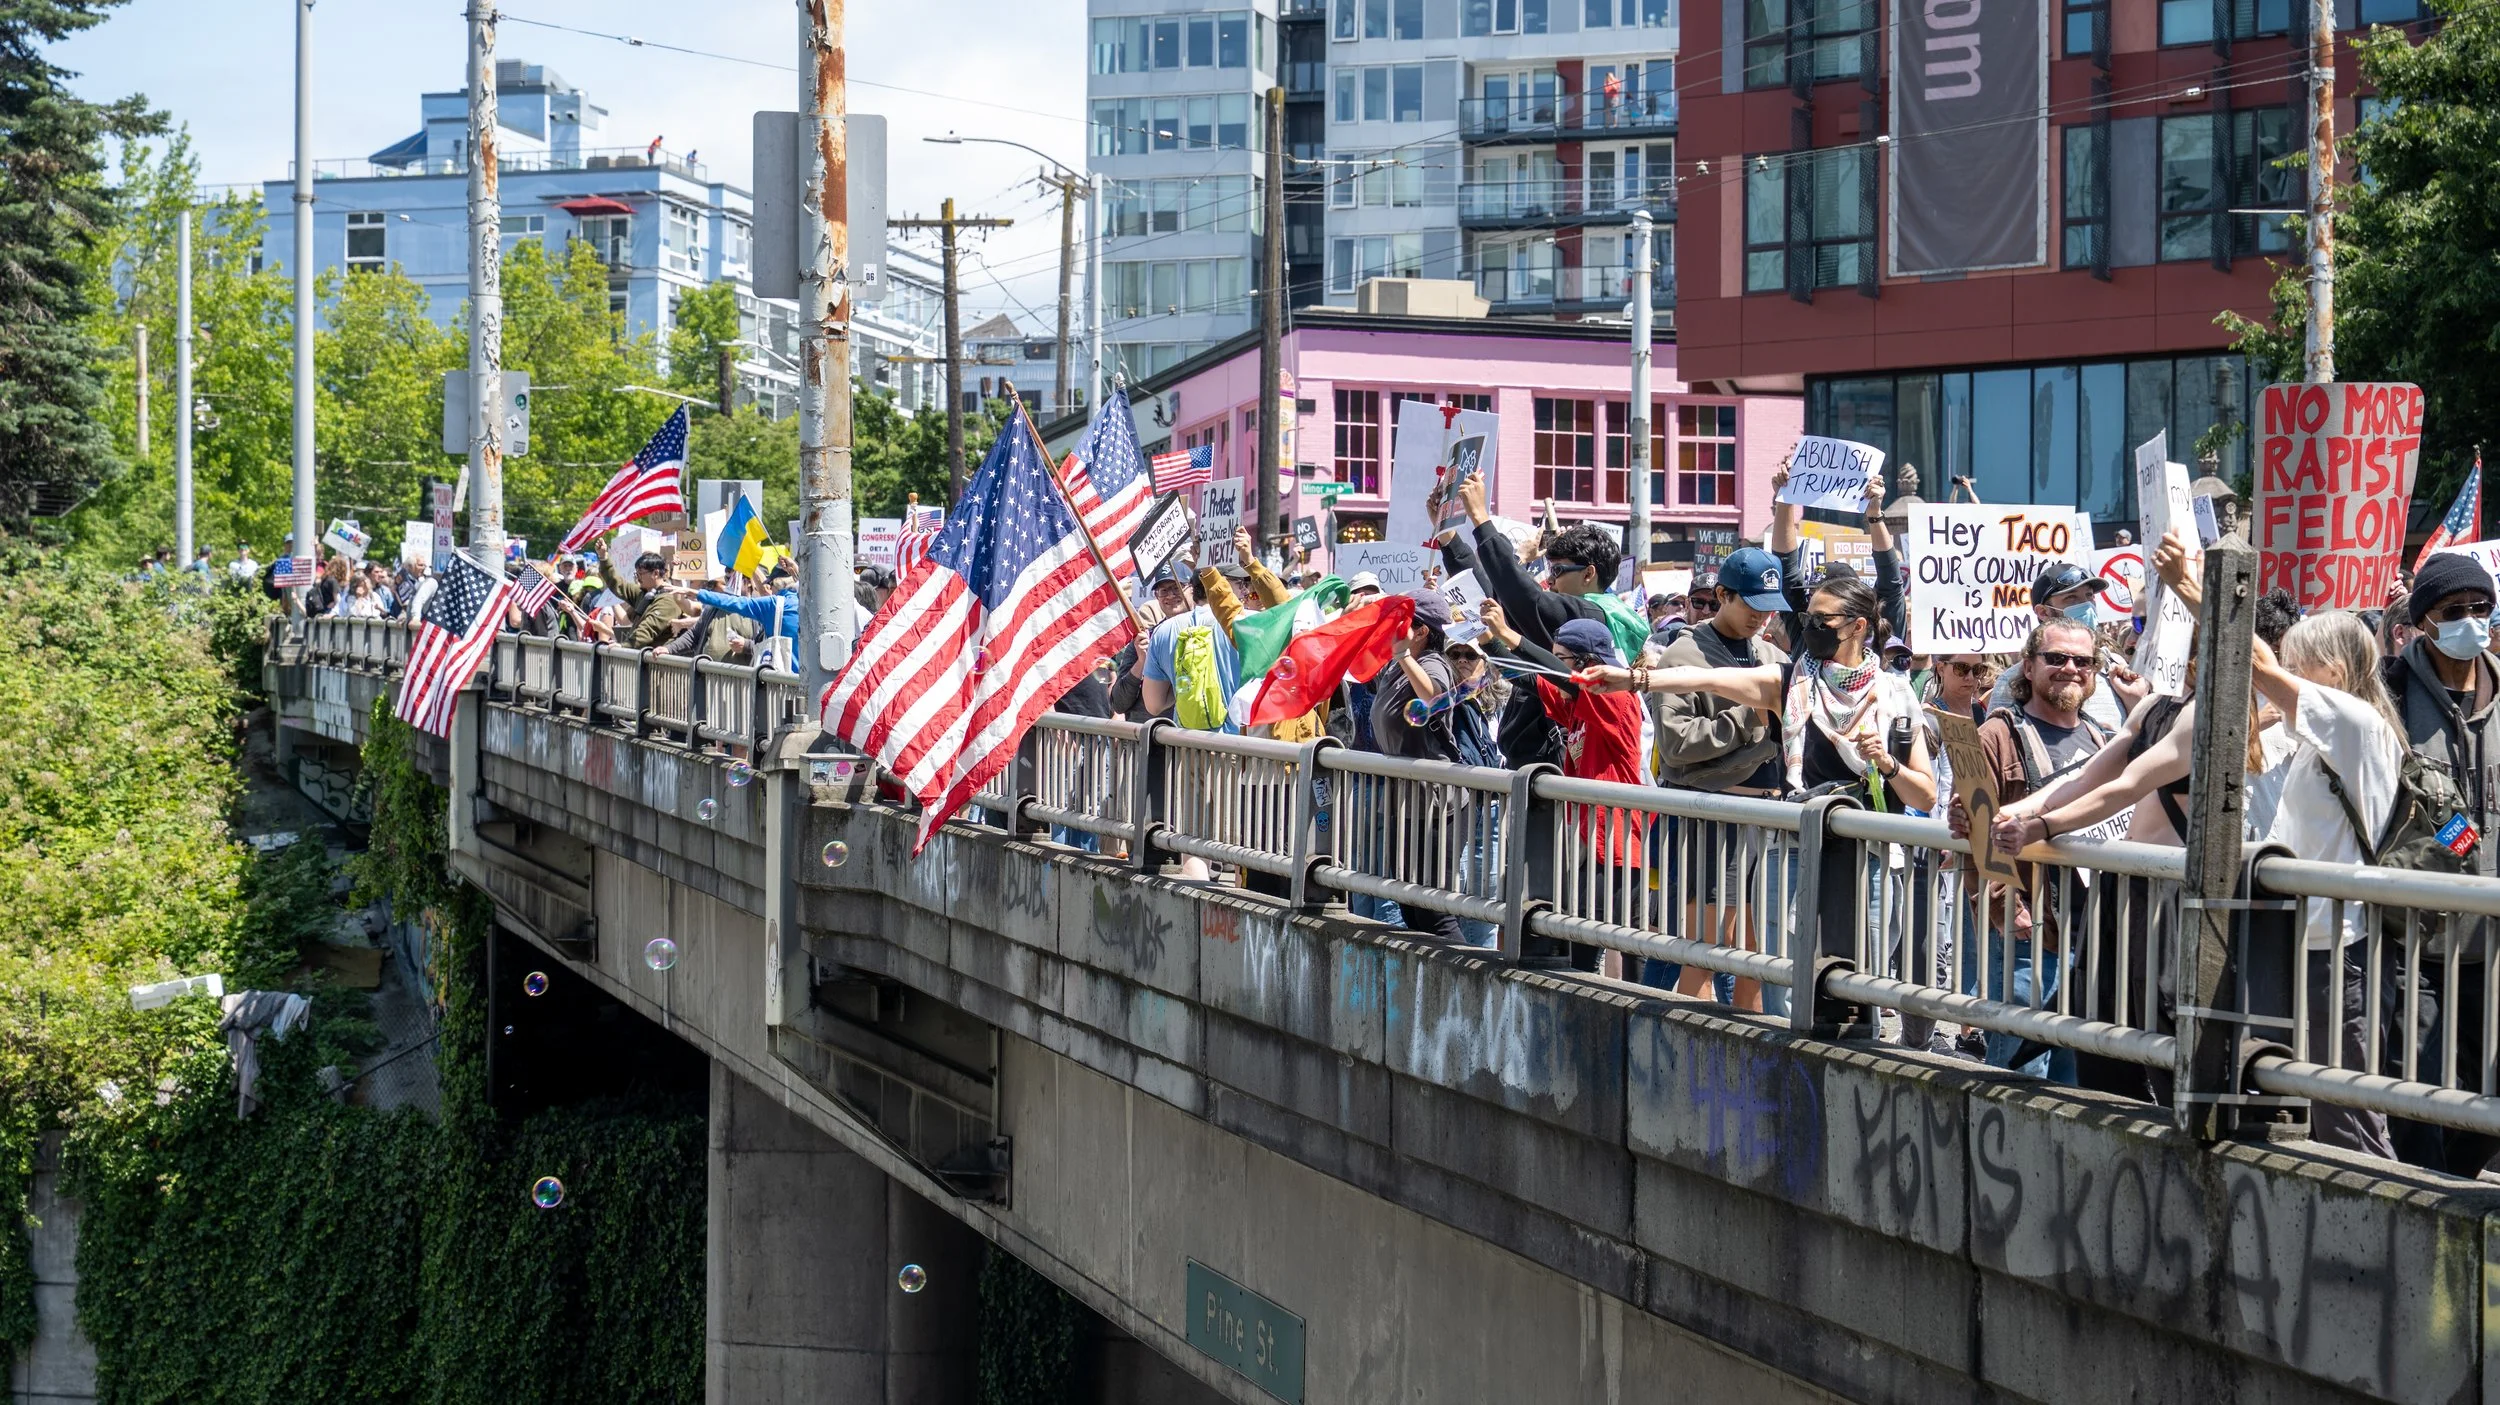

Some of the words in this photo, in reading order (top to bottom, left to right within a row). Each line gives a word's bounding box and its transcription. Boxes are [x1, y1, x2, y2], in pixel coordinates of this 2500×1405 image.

[2265, 385, 2330, 435] NO
[2343, 384, 2424, 436] MORE
[1793, 440, 1873, 472] ABOLISH
[2262, 436, 2420, 498] RAPIST
[1302, 483, 1324, 493] Minor
[1202, 490, 1209, 518] I
[1209, 488, 1236, 518] Protest
[1138, 506, 1180, 554] IMMIGRANTS
[1297, 522, 1311, 534] NO
[2264, 494, 2411, 554] FELON
[439, 536, 449, 546] as
[861, 534, 897, 542] CONGRESS!
[1153, 544, 1166, 561] NOT
[1168, 523, 1188, 547] KINGS
[1699, 530, 1713, 543] WE
[1715, 531, 1735, 545] WERE
[1929, 515, 1985, 558] Hey
[1999, 514, 2070, 554] TACO
[861, 554, 893, 564] PINE!
[1208, 537, 1235, 565] NEXT!
[1359, 550, 1419, 566] America's
[1695, 554, 1706, 564] TO
[1709, 555, 1717, 565] BE
[1699, 544, 1714, 554] NOT
[1714, 545, 1734, 557] PAID
[1836, 543, 1850, 553] NO
[1855, 544, 1873, 553] KIN
[1378, 565, 1420, 584] ONLY
[1695, 564, 1704, 573] WE
[1919, 555, 1964, 585] OUR
[1964, 585, 1983, 608] is
[1970, 787, 2015, 877] 2
[1206, 1291, 1244, 1353] Pine
[1256, 1319, 1279, 1377] St.
